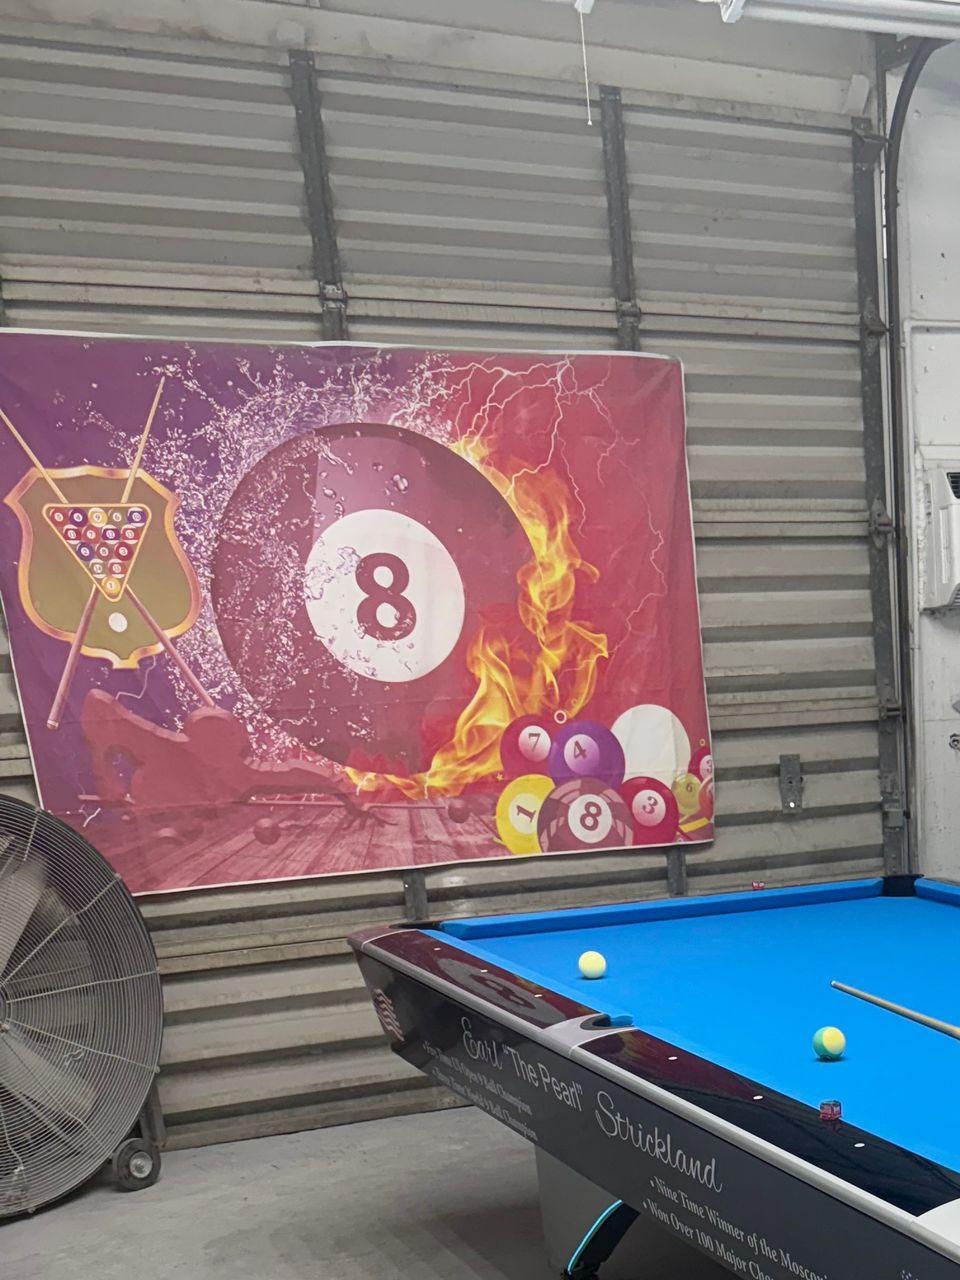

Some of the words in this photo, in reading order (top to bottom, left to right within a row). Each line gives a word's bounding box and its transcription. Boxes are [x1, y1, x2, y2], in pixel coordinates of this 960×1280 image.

[355, 552, 417, 641] 8
[528, 732, 541, 752] 7
[573, 740, 587, 760] 4
[686, 782, 693, 792] 6
[516, 804, 537, 823] 1
[579, 801, 602, 831] 8
[642, 796, 658, 815] 3
[461, 1016, 503, 1070] Earl
[595, 1091, 722, 1193] Strickland
[654, 1176, 678, 1203] Nine
[679, 1189, 706, 1219] Time
[705, 1206, 744, 1242] Winner
[747, 1233, 760, 1256] of
[760, 1238, 778, 1262] the
[647, 1198, 670, 1224] Won
[670, 1212, 694, 1240] Over
[696, 1228, 714, 1252] 100
[716, 1240, 748, 1276] Major
